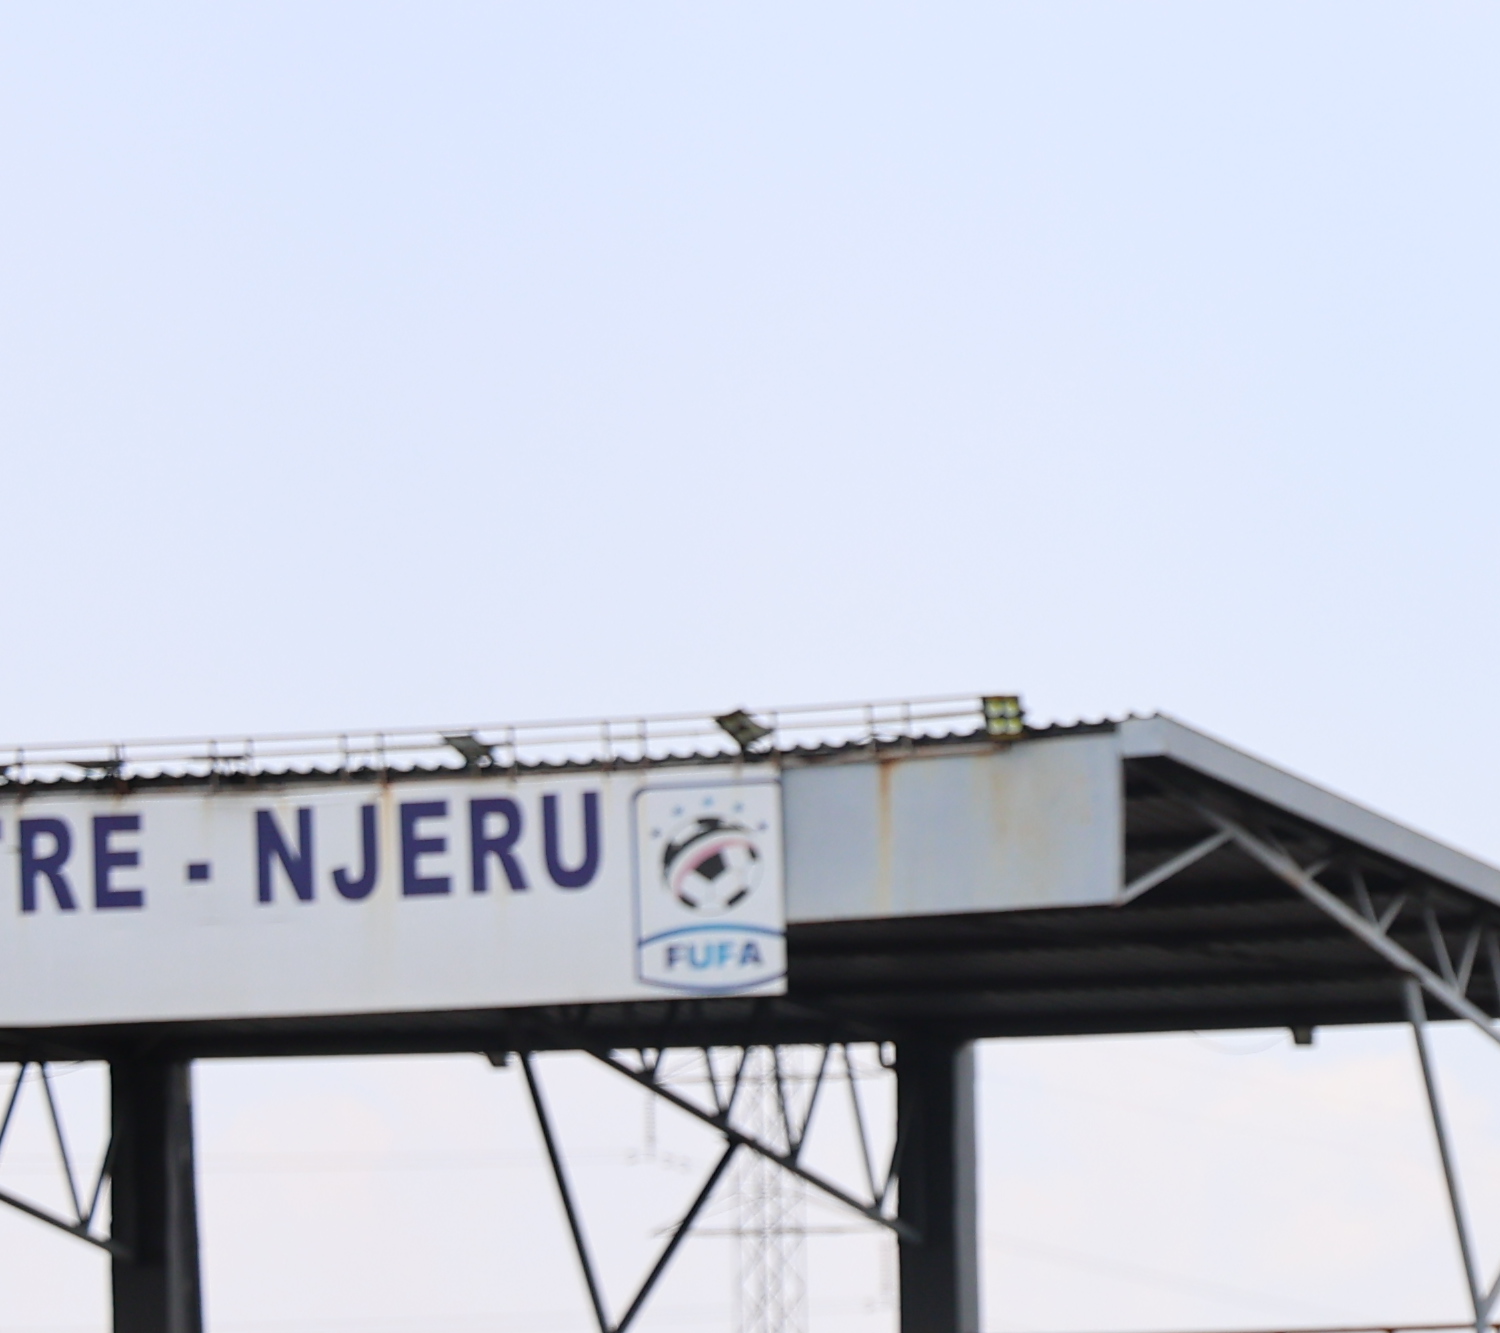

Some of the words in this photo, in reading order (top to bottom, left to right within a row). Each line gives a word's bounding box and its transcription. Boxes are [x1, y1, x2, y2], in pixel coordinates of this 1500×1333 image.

[0, 814, 144, 913] RE
[254, 790, 602, 904] NJERU
[664, 941, 765, 969] FUFA
